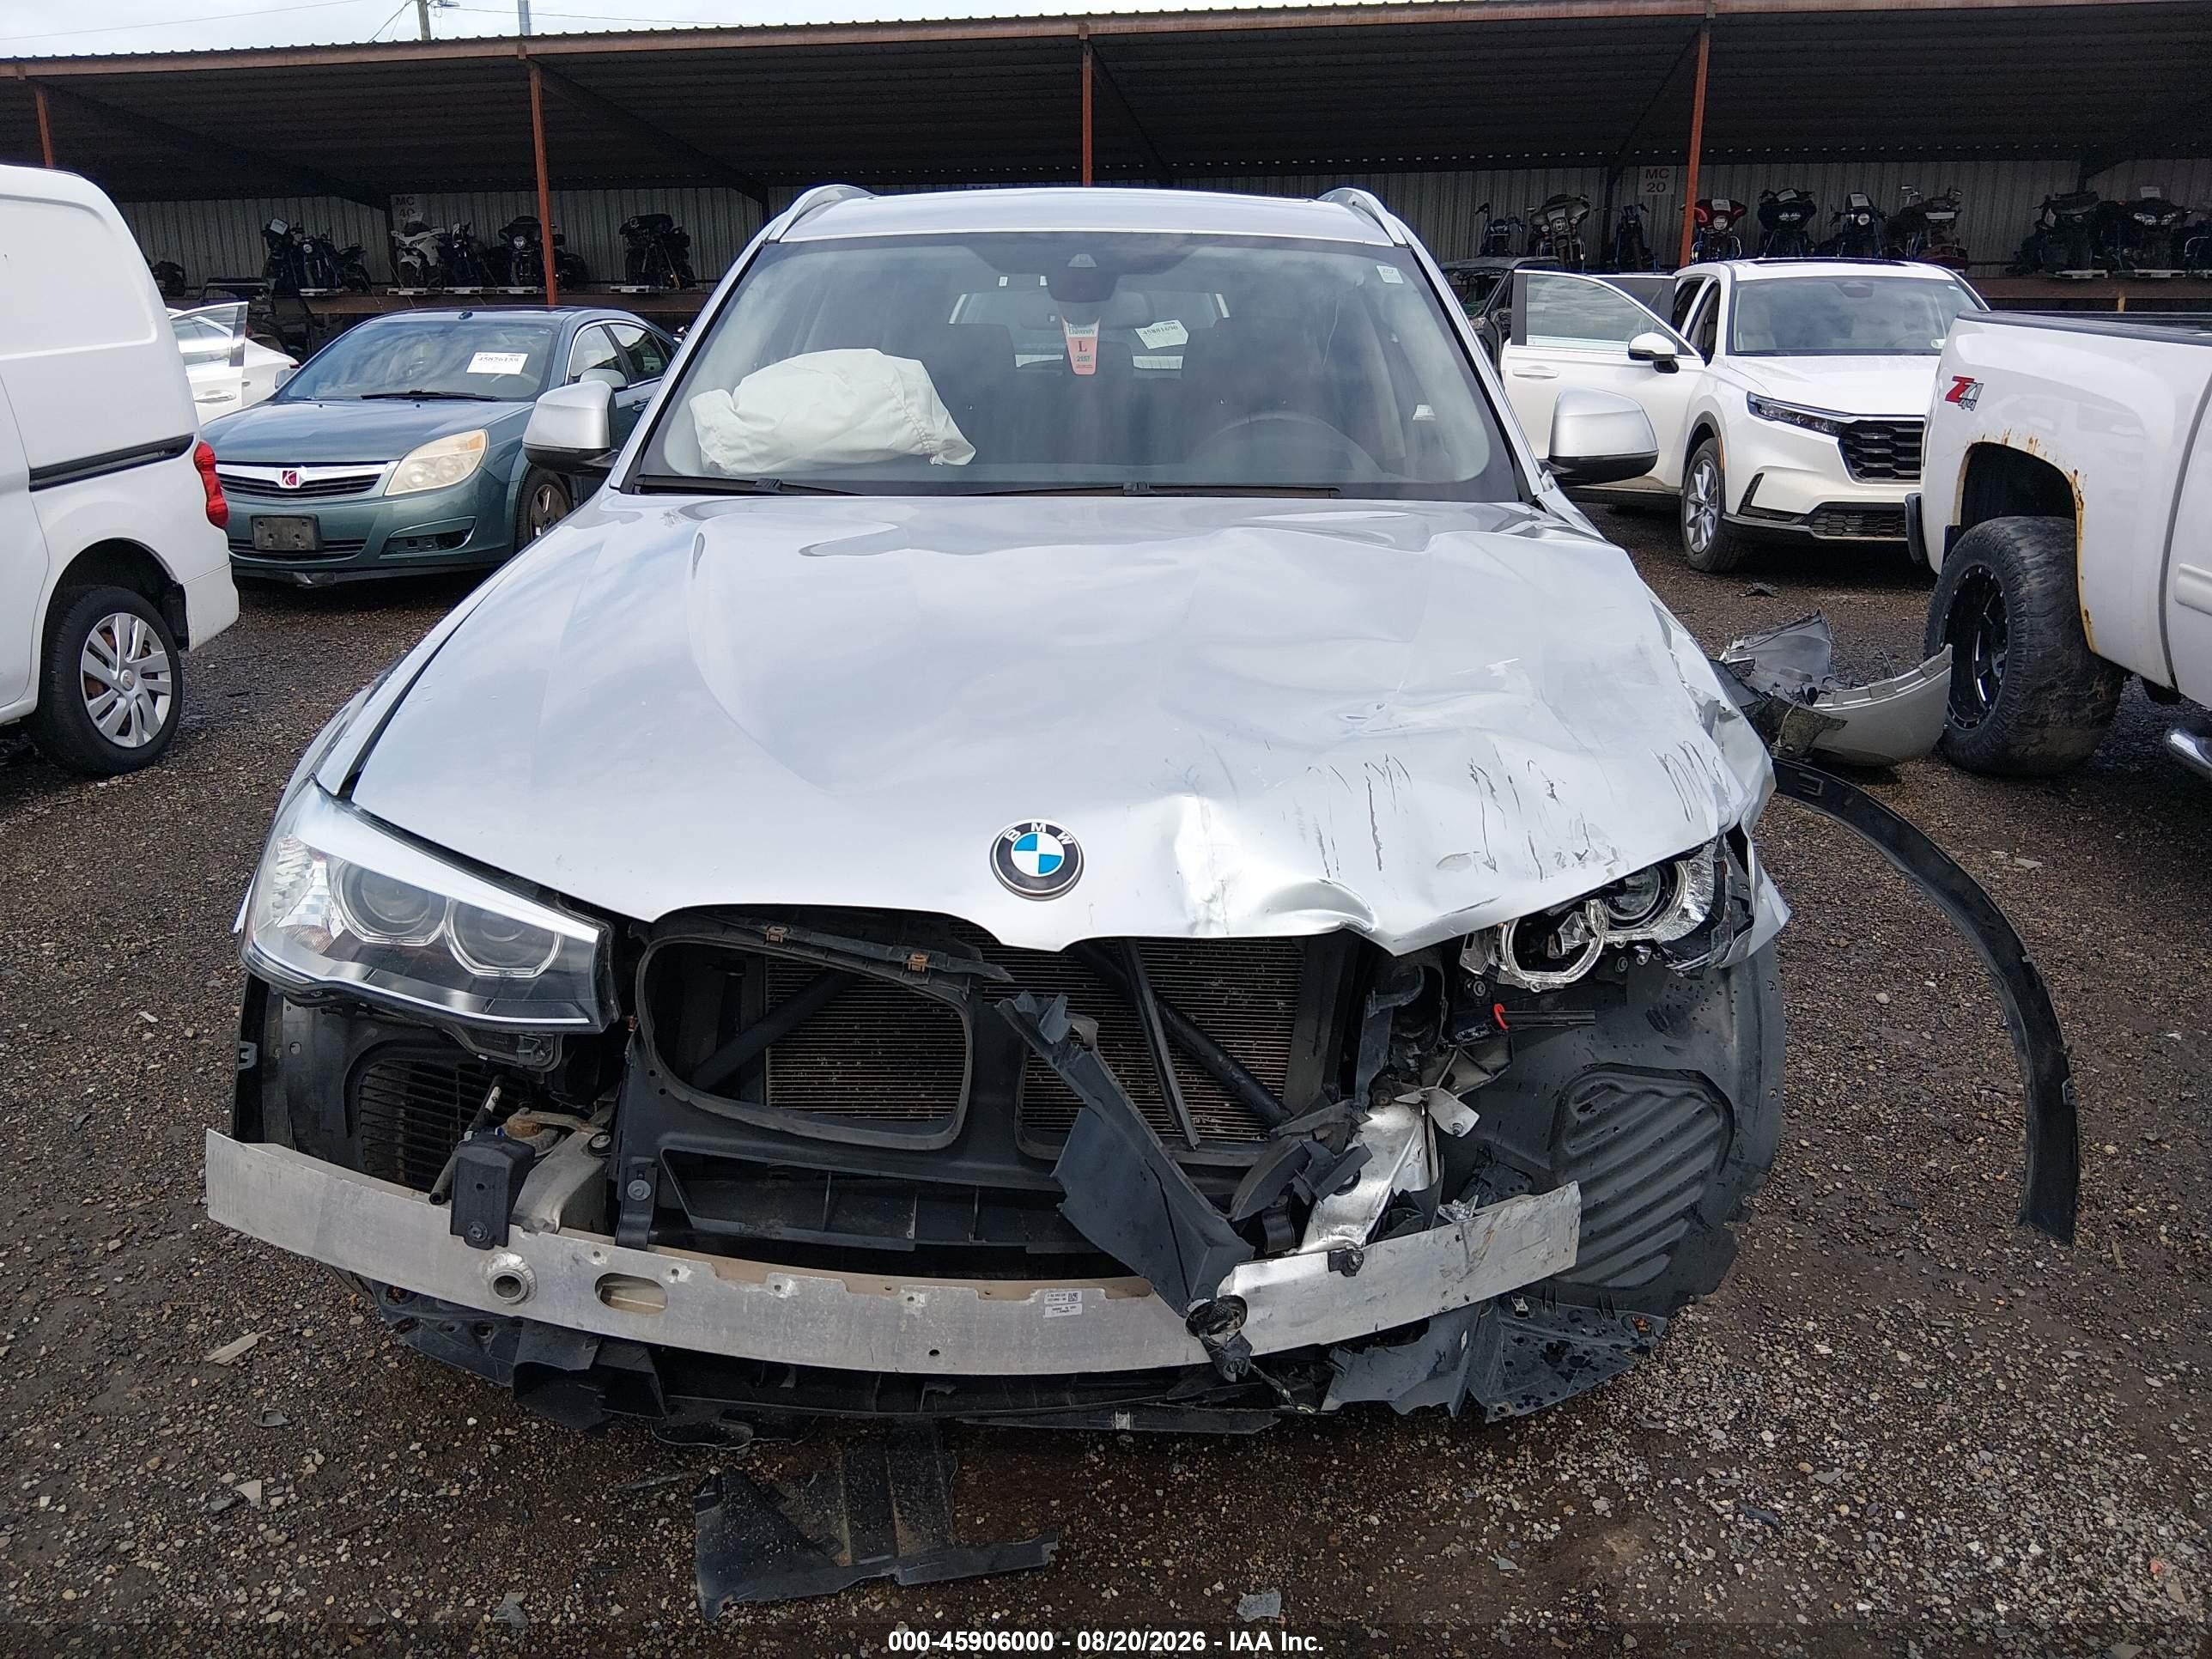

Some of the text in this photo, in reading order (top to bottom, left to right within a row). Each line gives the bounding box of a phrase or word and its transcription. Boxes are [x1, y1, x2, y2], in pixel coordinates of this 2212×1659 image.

[1645, 168, 1670, 179] MC
[1646, 181, 1667, 193] 20
[396, 196, 415, 206] MC
[1078, 340, 1088, 352] L
[1945, 374, 1984, 403] Z71
[1004, 823, 1073, 845] BMW
